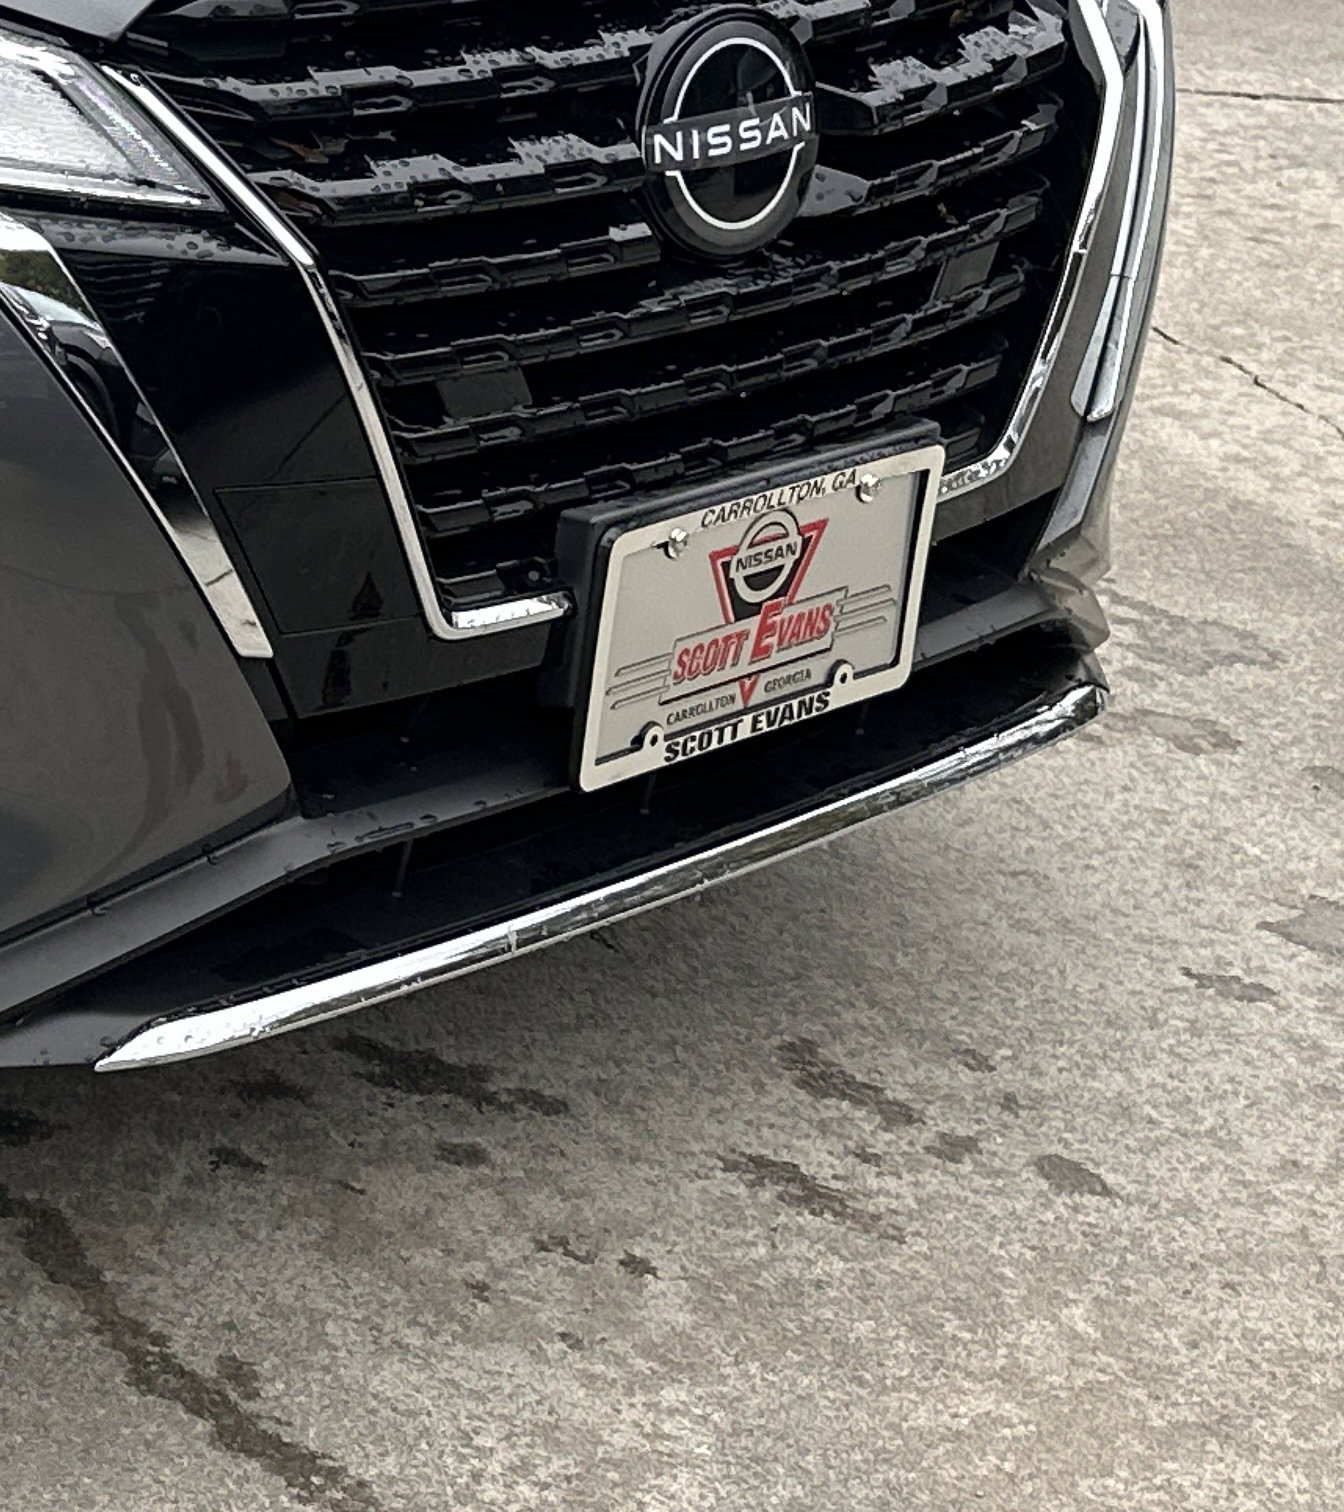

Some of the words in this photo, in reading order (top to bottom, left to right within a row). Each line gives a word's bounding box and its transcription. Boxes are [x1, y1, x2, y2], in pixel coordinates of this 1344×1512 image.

[653, 102, 811, 164] NISSAN
[700, 477, 826, 528] CARROLLTON,
[832, 469, 857, 492] GA
[735, 541, 798, 573] NISSAN
[672, 629, 751, 685] SCOTT
[666, 693, 737, 726] CARROLLTON
[763, 668, 812, 694] GEORGIA
[663, 718, 744, 763] SCOTT
[749, 690, 831, 734] EVANS
